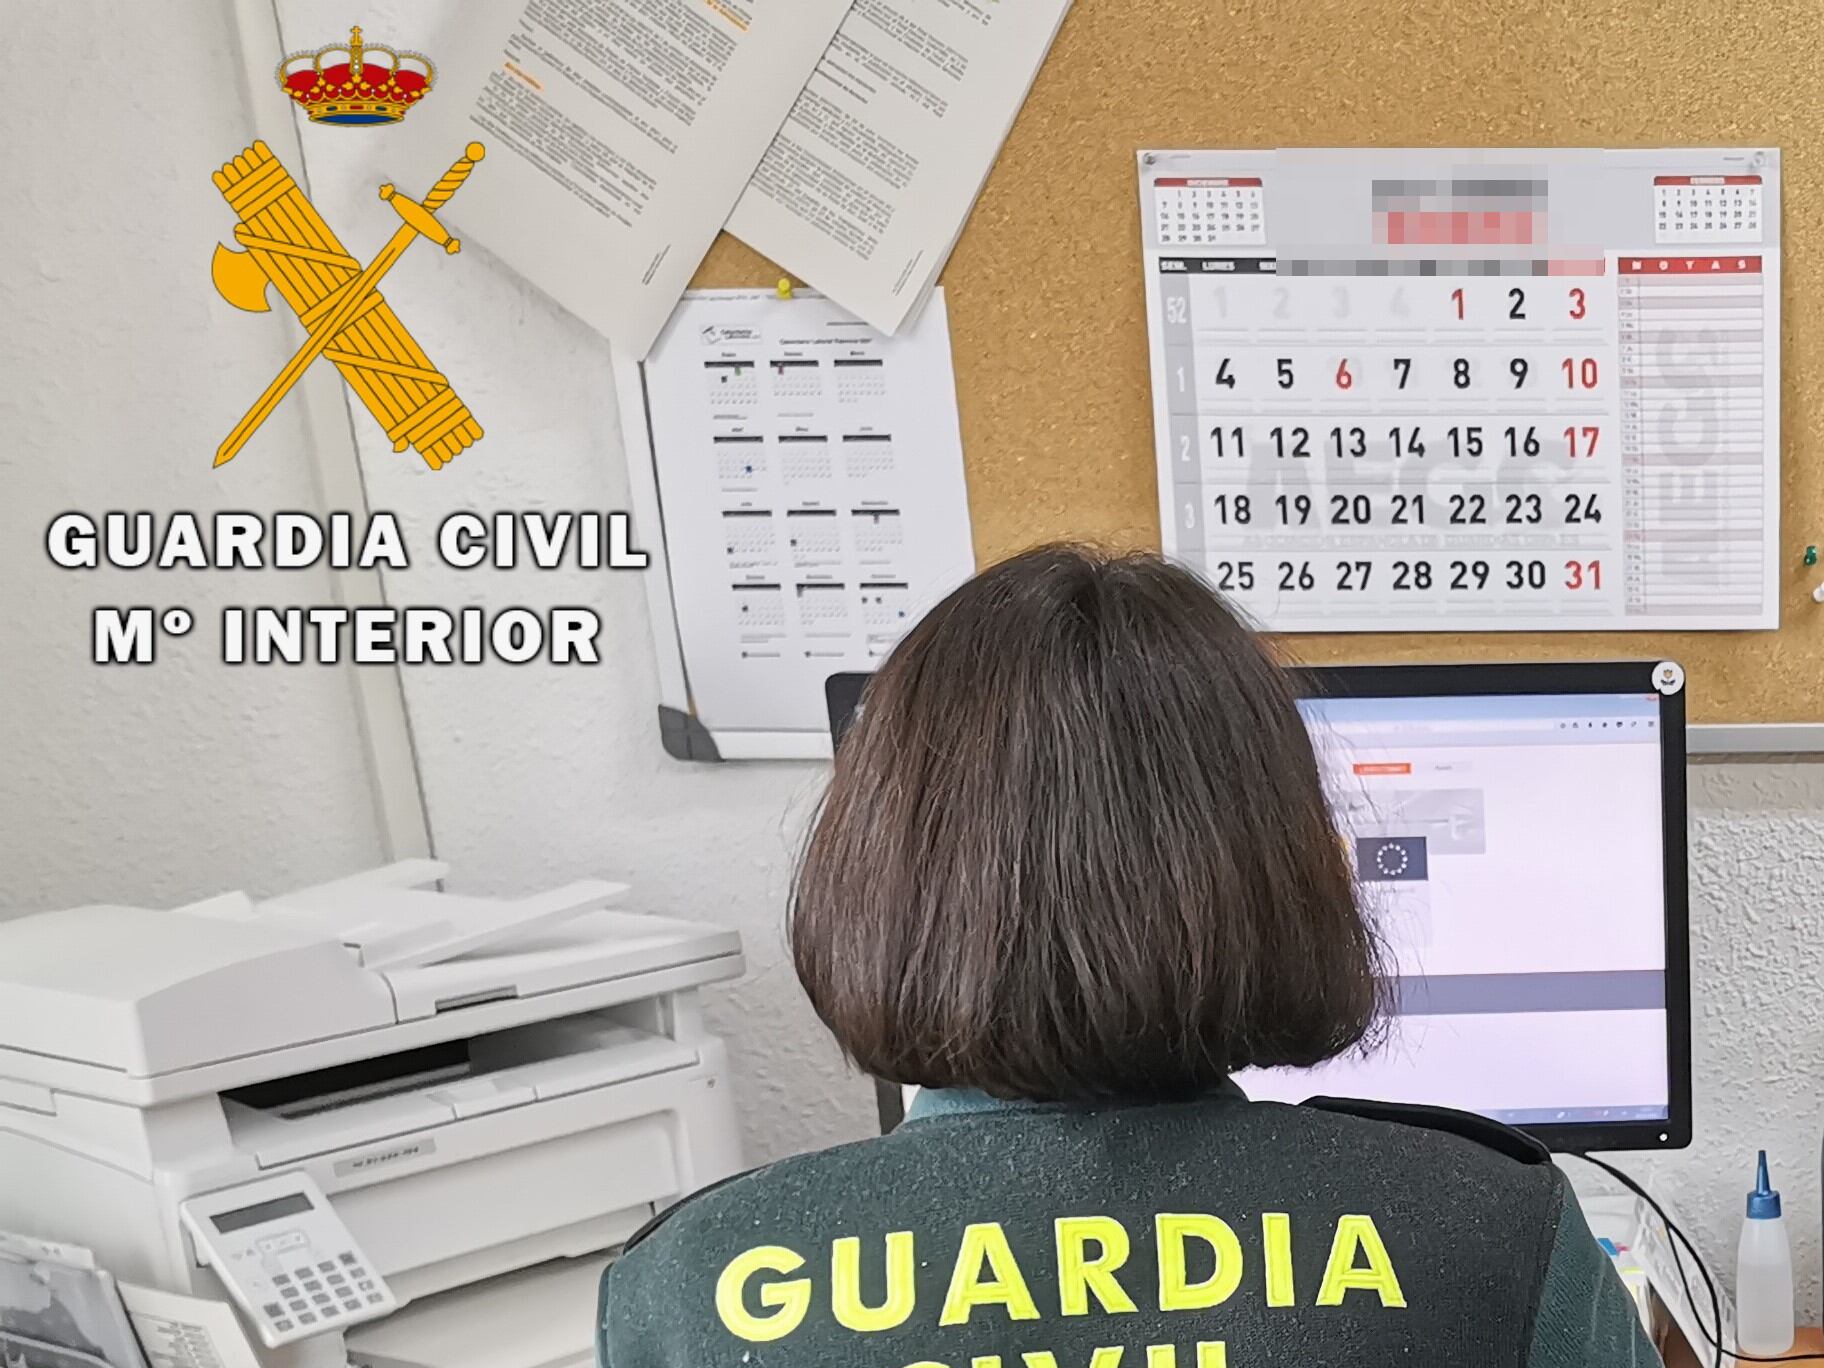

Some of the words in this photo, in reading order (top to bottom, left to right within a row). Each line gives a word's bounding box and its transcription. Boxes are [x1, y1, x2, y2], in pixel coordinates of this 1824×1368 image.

[1167, 296, 1187, 324] 52
[1451, 288, 1464, 320] 1
[1508, 288, 1526, 320] 2
[1569, 287, 1586, 320] 3
[1177, 366, 1186, 392] 1
[1215, 358, 1236, 389] 4
[1276, 358, 1294, 390] 5
[1336, 358, 1352, 390] 6
[1393, 358, 1412, 390] 7
[1453, 358, 1471, 389] 8
[1509, 358, 1529, 389] 9
[1562, 358, 1598, 389] 10
[1180, 435, 1191, 462] 2
[1210, 426, 1244, 458] 11
[1270, 426, 1311, 458] 12
[1330, 426, 1367, 459] 13
[1388, 426, 1426, 458] 14
[1447, 426, 1483, 458] 15
[1504, 425, 1540, 458] 16
[1564, 426, 1599, 458] 17
[1183, 502, 1195, 531] 3
[1214, 494, 1252, 525] 18
[1275, 494, 1312, 525] 19
[1330, 494, 1372, 525] 20
[1391, 494, 1425, 525] 21
[1449, 493, 1487, 525] 22
[1505, 493, 1543, 524] 23
[1564, 493, 1602, 524] 24
[1217, 561, 1254, 592] 25
[1278, 561, 1315, 591] 26
[1336, 561, 1372, 591] 27
[1392, 560, 1433, 591] 28
[1449, 560, 1490, 590] 29
[1505, 560, 1546, 590] 30
[1565, 560, 1600, 590] 31
[716, 1212, 1407, 1342] GUARDIA
